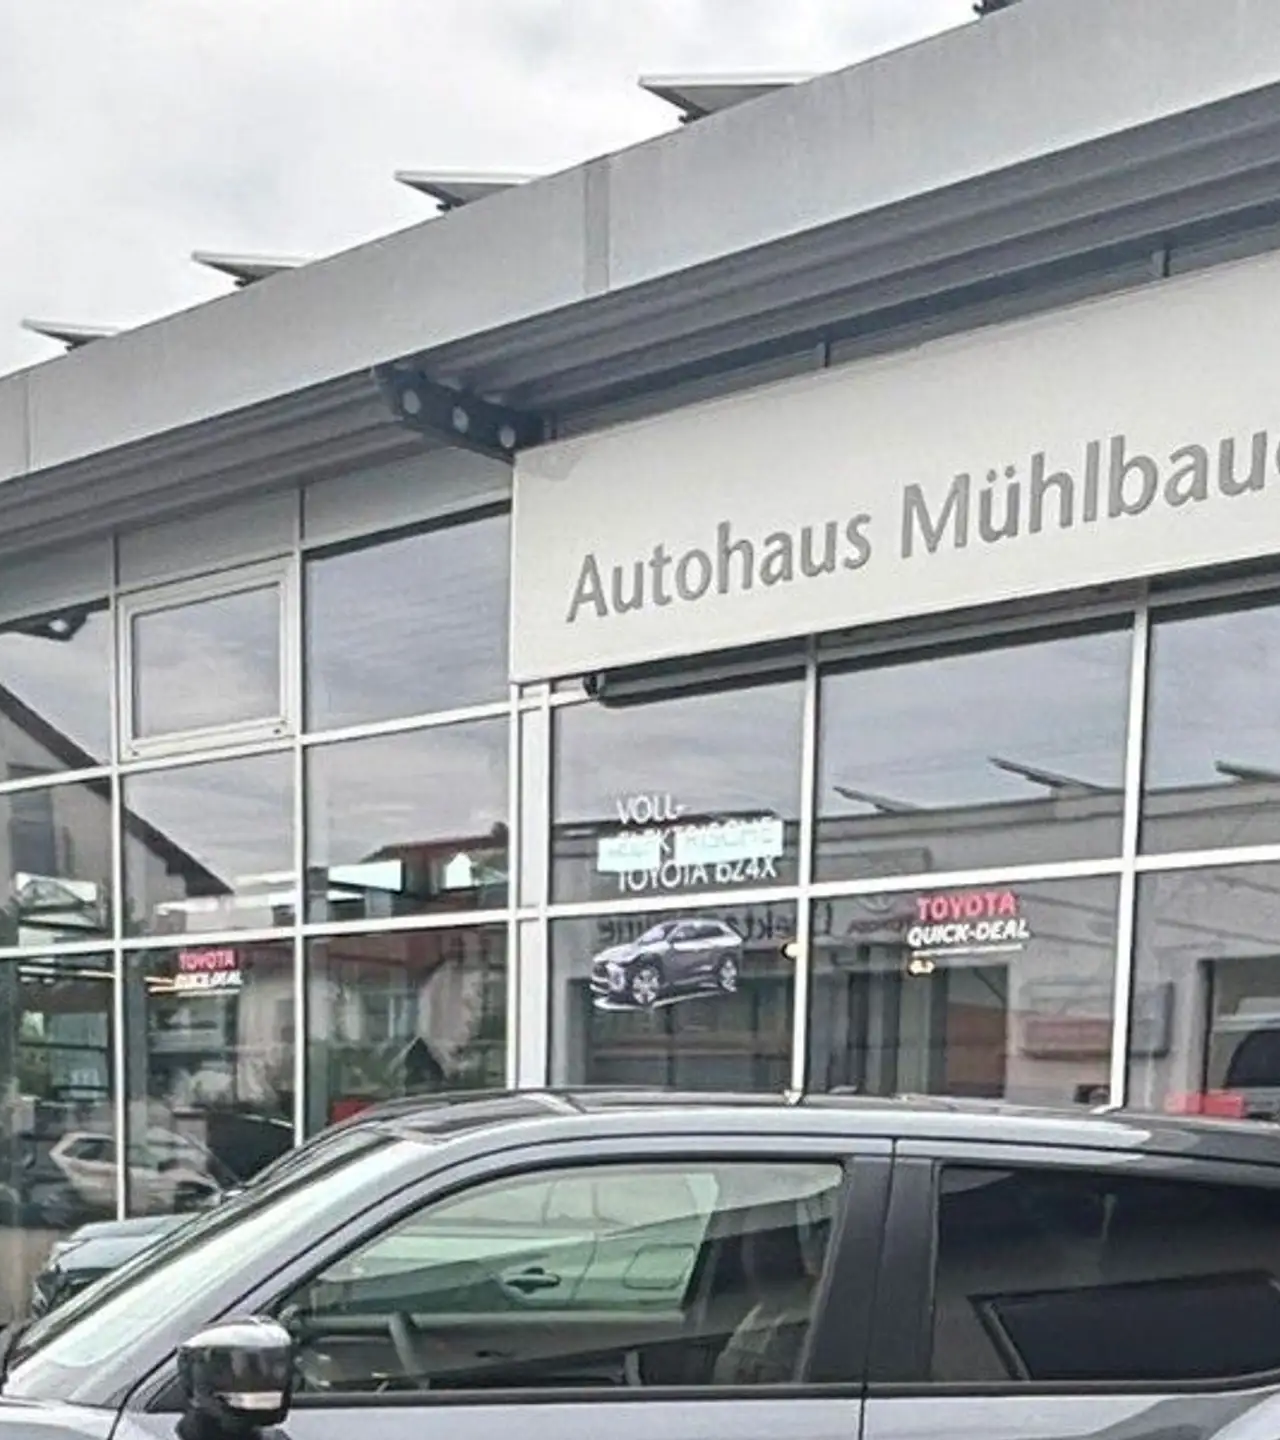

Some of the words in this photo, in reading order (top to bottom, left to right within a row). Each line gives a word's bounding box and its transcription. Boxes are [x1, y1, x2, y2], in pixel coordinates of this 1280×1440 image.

[566, 513, 872, 623] Autohaus
[620, 858, 708, 892] TOYOTA
[917, 891, 1018, 921] TOYOTA
[907, 918, 1031, 947] QUICK-DEAL
[179, 949, 236, 970] TOYOTA
